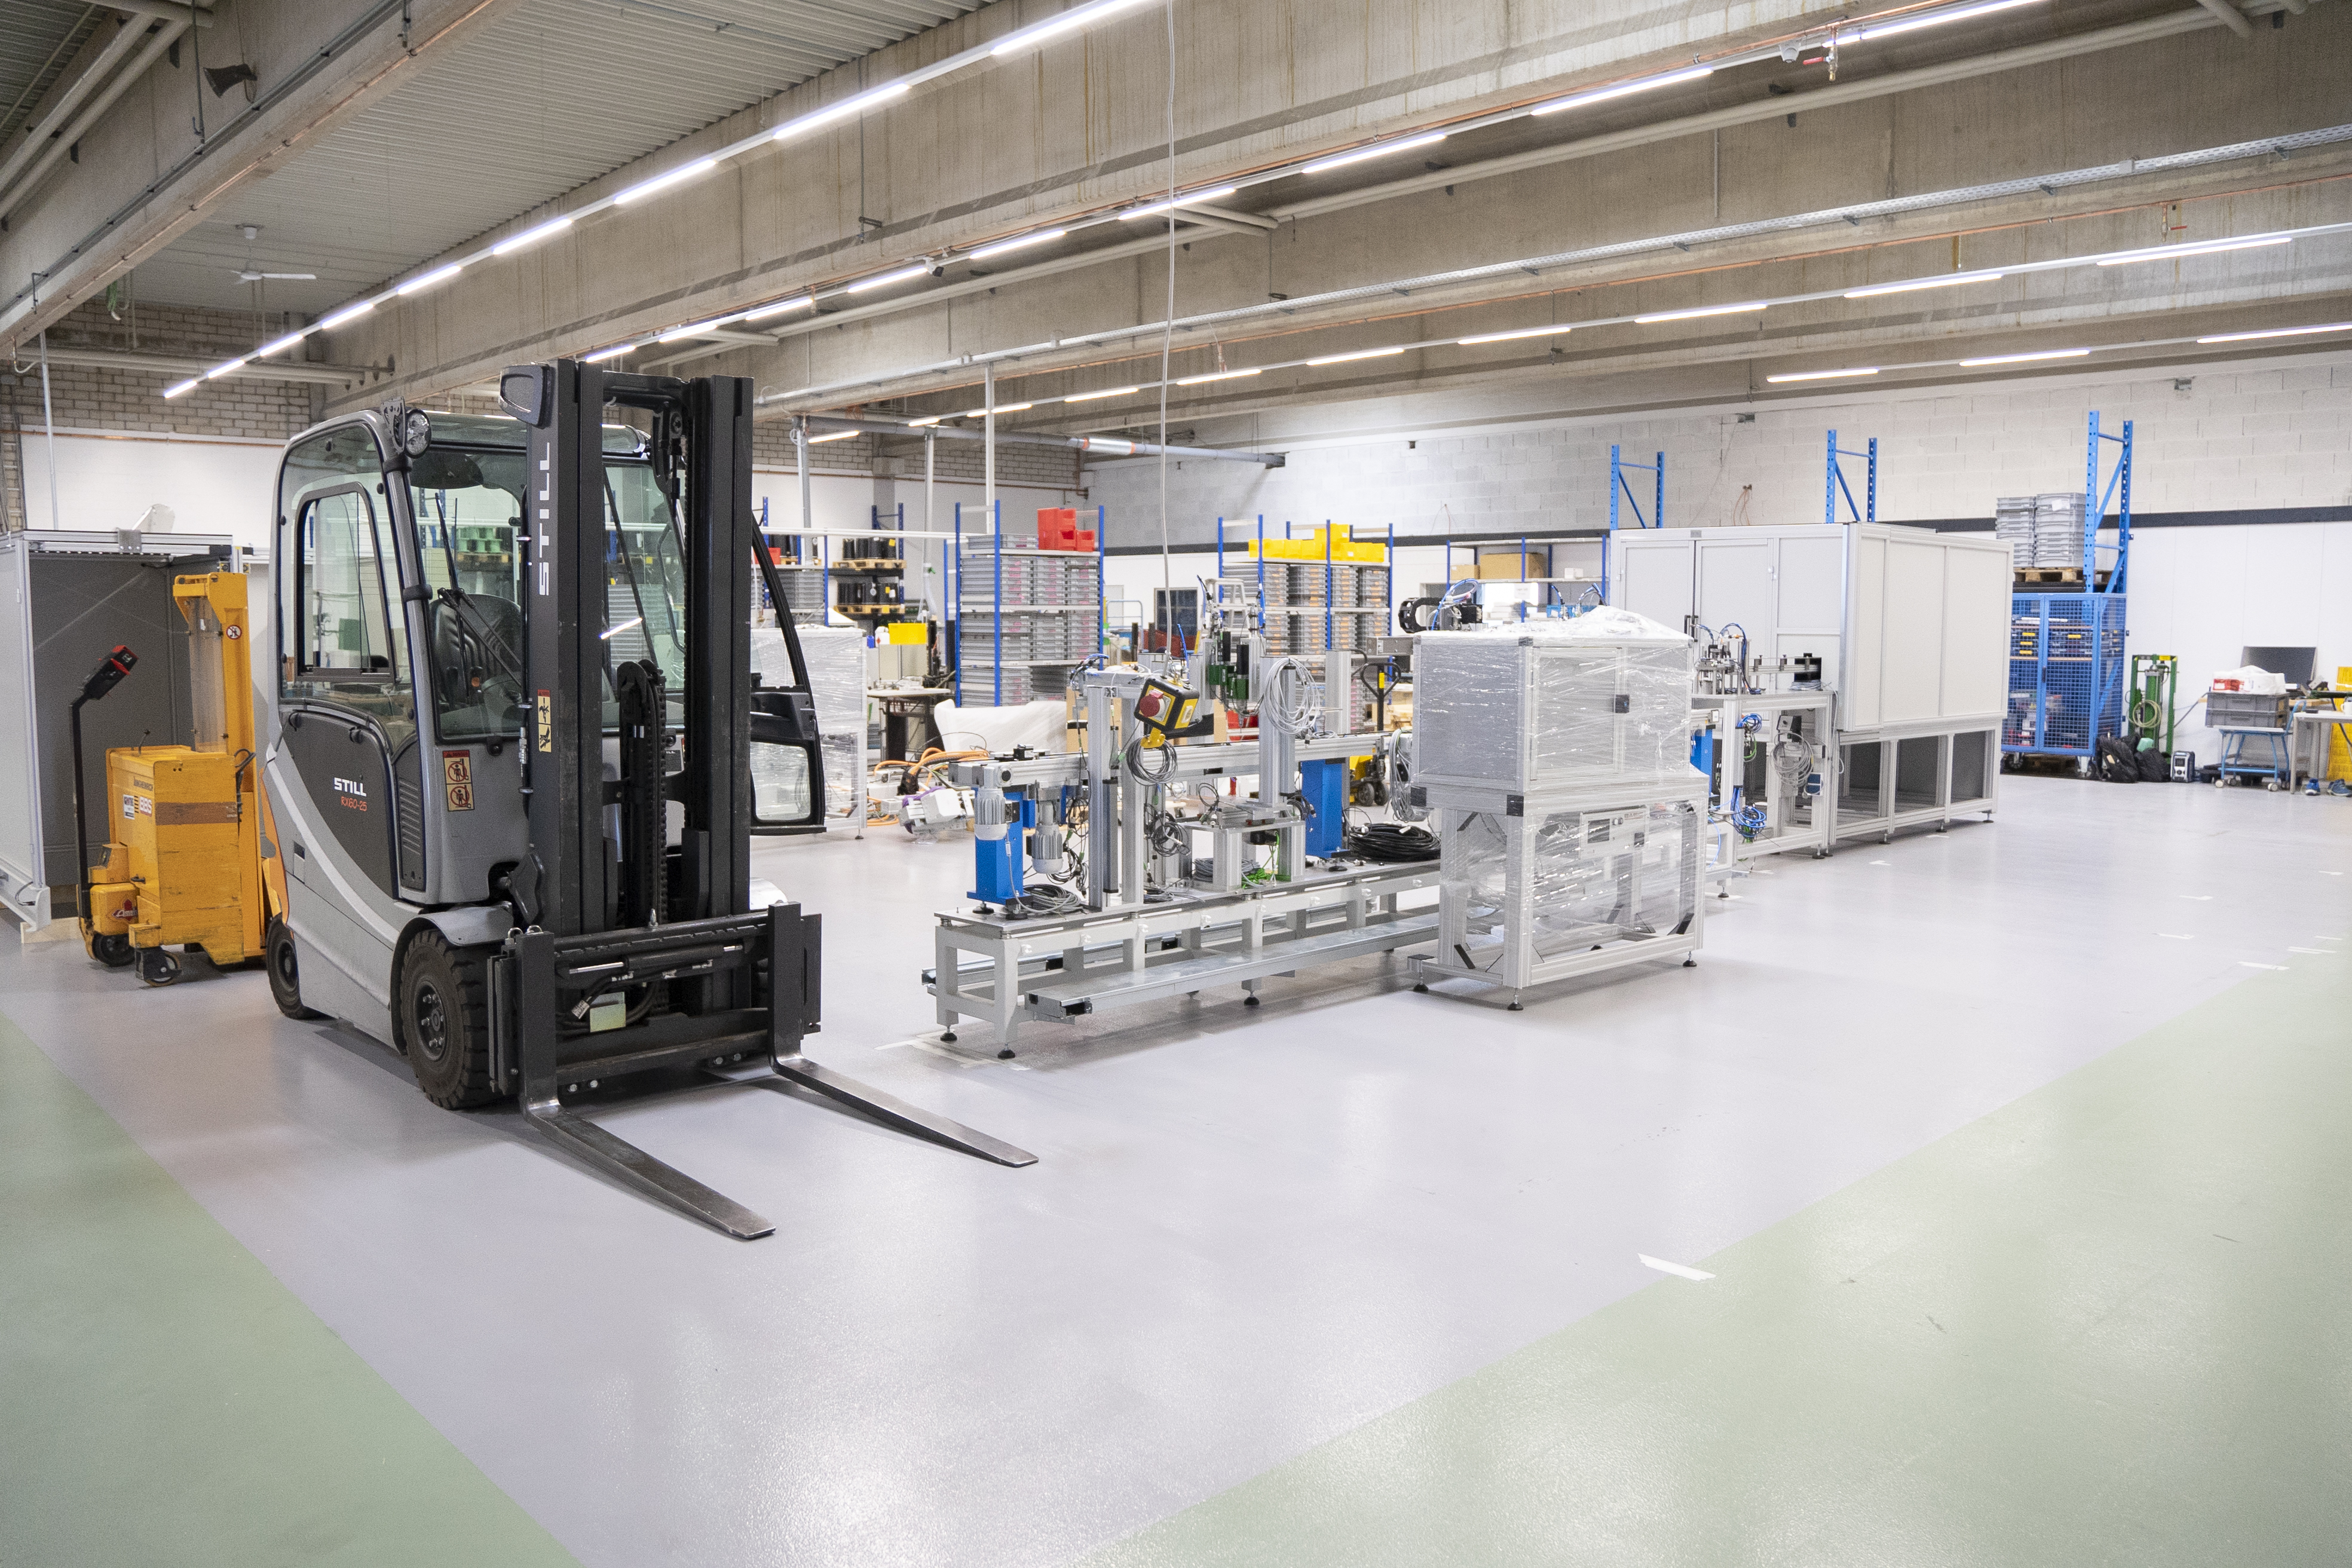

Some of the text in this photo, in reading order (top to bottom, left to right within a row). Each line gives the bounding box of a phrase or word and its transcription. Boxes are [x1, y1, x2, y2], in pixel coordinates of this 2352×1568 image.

[539, 442, 550, 596] STILL
[333, 777, 368, 797] STILL
[340, 795, 368, 812] RX60-25
